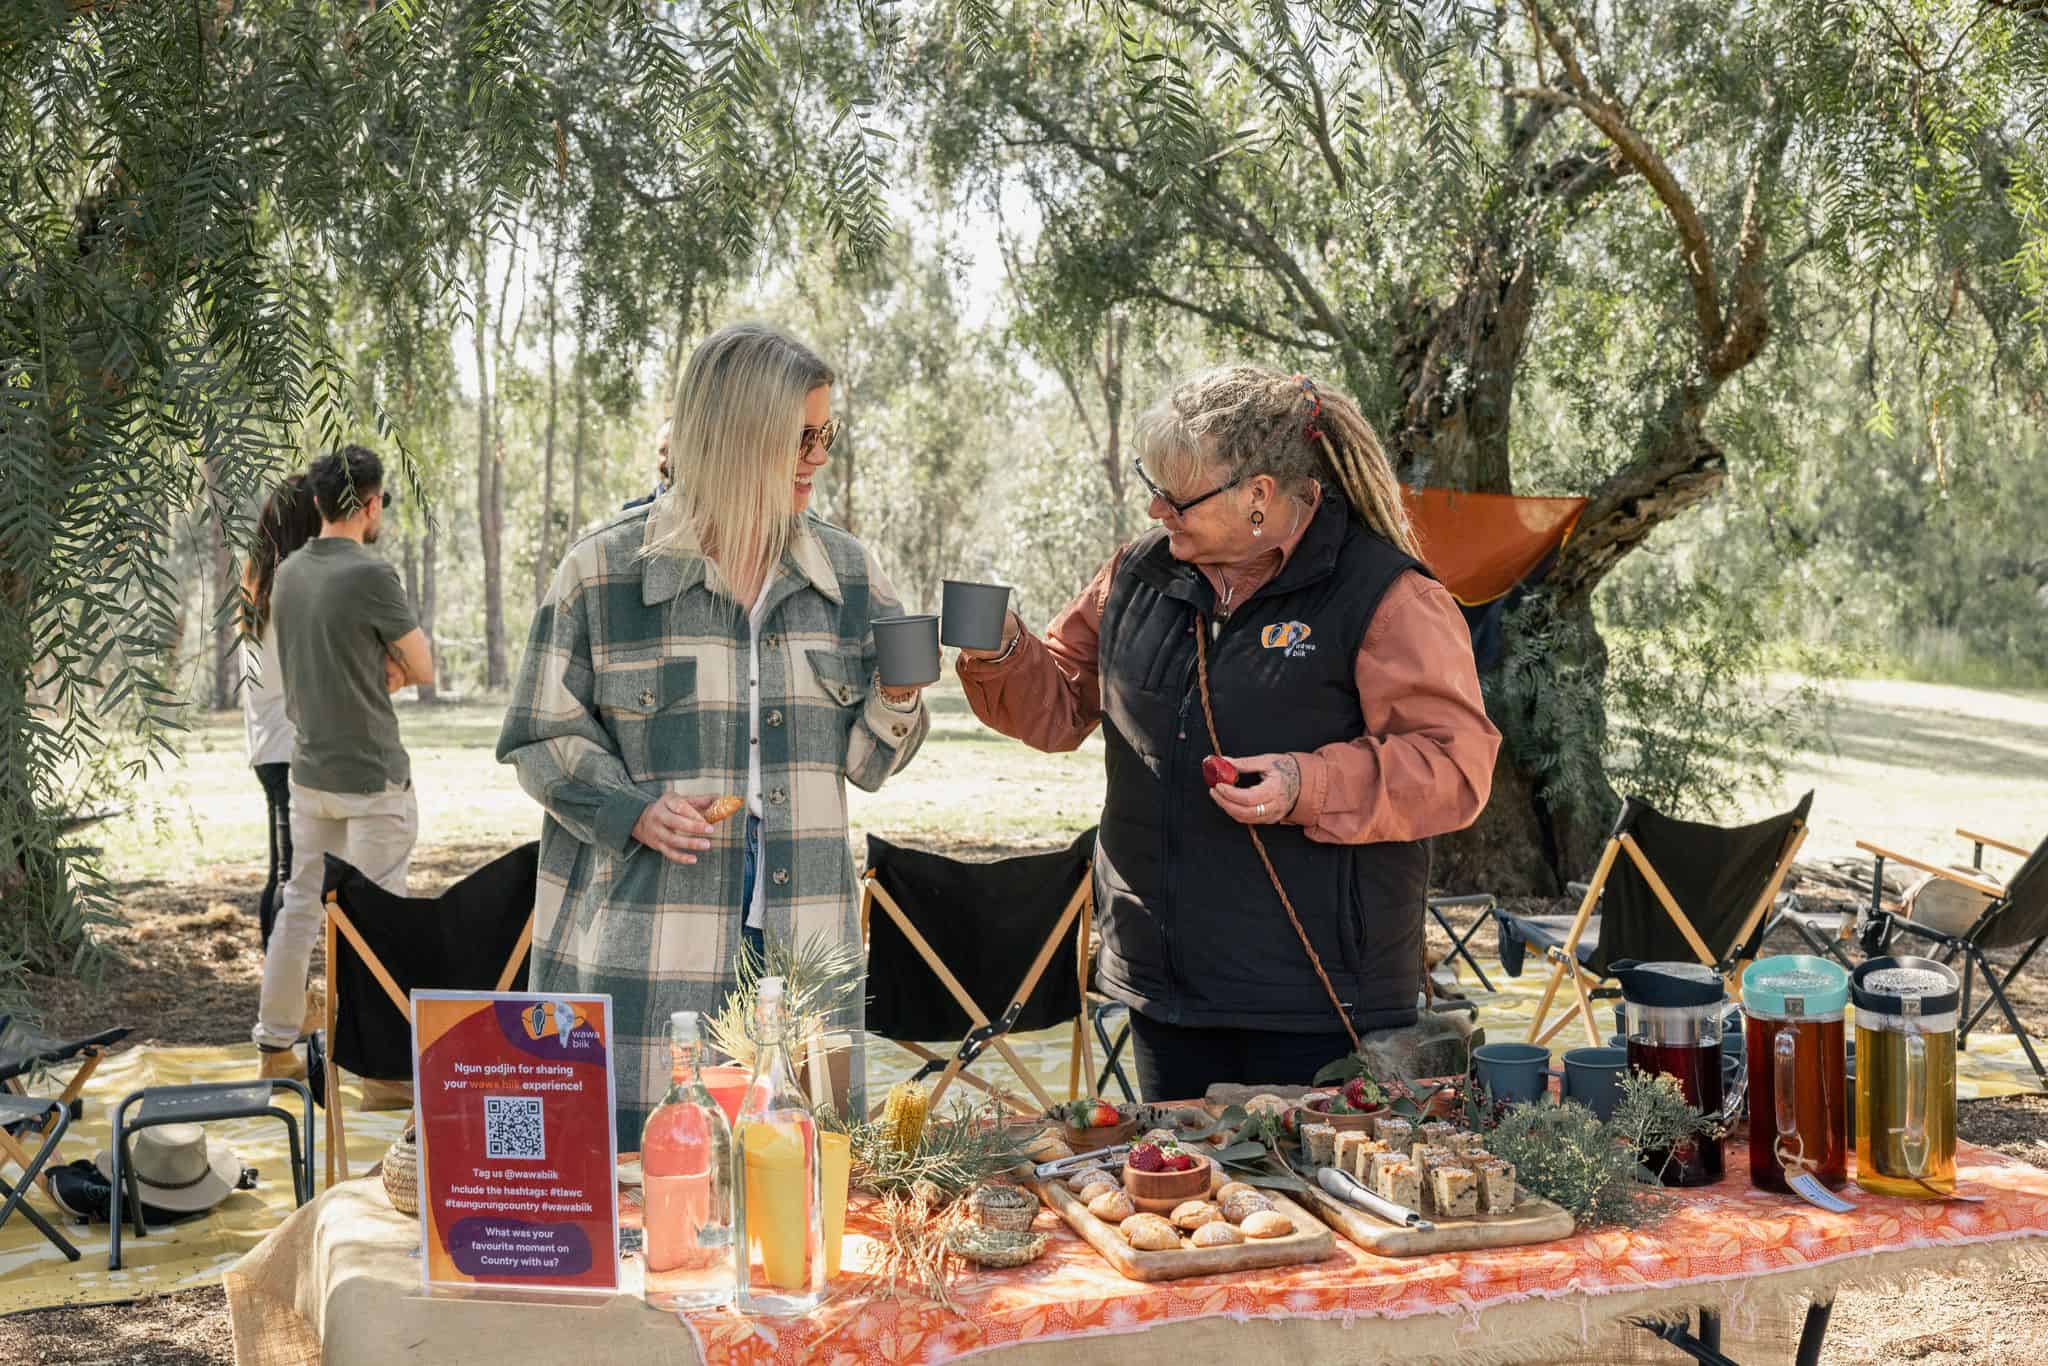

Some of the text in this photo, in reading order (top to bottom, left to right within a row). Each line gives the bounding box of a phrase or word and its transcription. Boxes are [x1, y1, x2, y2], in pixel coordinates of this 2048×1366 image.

[572, 1031, 600, 1039] wawa
[572, 1039, 590, 1049] biik
[454, 1063, 573, 1077] Ngun godjin for sharing
[444, 1080, 467, 1090] your
[470, 1081, 499, 1089] wawa
[522, 1081, 583, 1092] experience!
[472, 1168, 559, 1180] Tag us @wawabiik
[451, 1184, 485, 1194] Include
[486, 1185, 502, 1195] the
[504, 1185, 548, 1198] hashtags:
[445, 1199, 593, 1212] #taungurungcountry #wawabiik
[485, 1226, 554, 1239] What was your
[472, 1241, 514, 1251] favourite
[516, 1243, 555, 1253] moment
[480, 1255, 560, 1267] Country with us?
